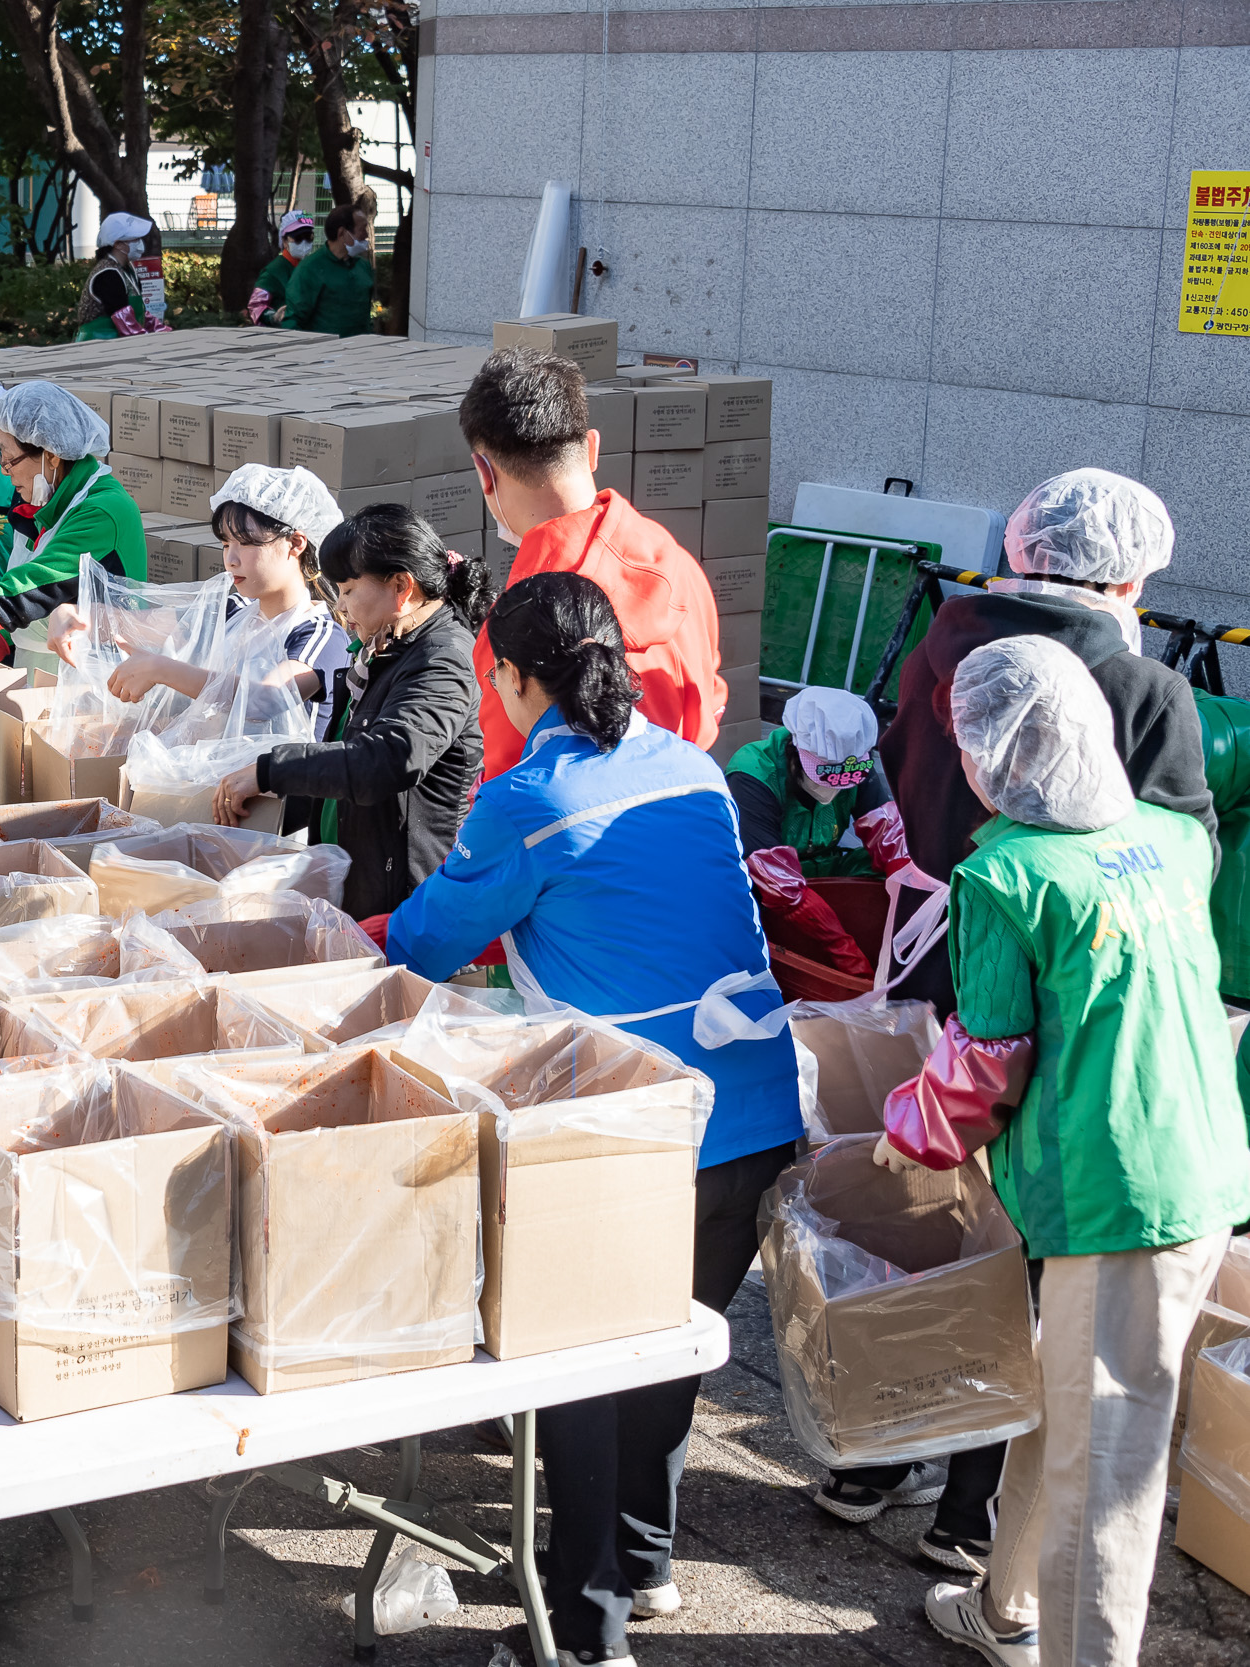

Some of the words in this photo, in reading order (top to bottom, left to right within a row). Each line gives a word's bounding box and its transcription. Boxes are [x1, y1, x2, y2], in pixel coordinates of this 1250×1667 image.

[1188, 266, 1223, 274] 불법주차를
[1186, 278, 1214, 286] 바랍니다.
[1095, 844, 1164, 880] SMU
